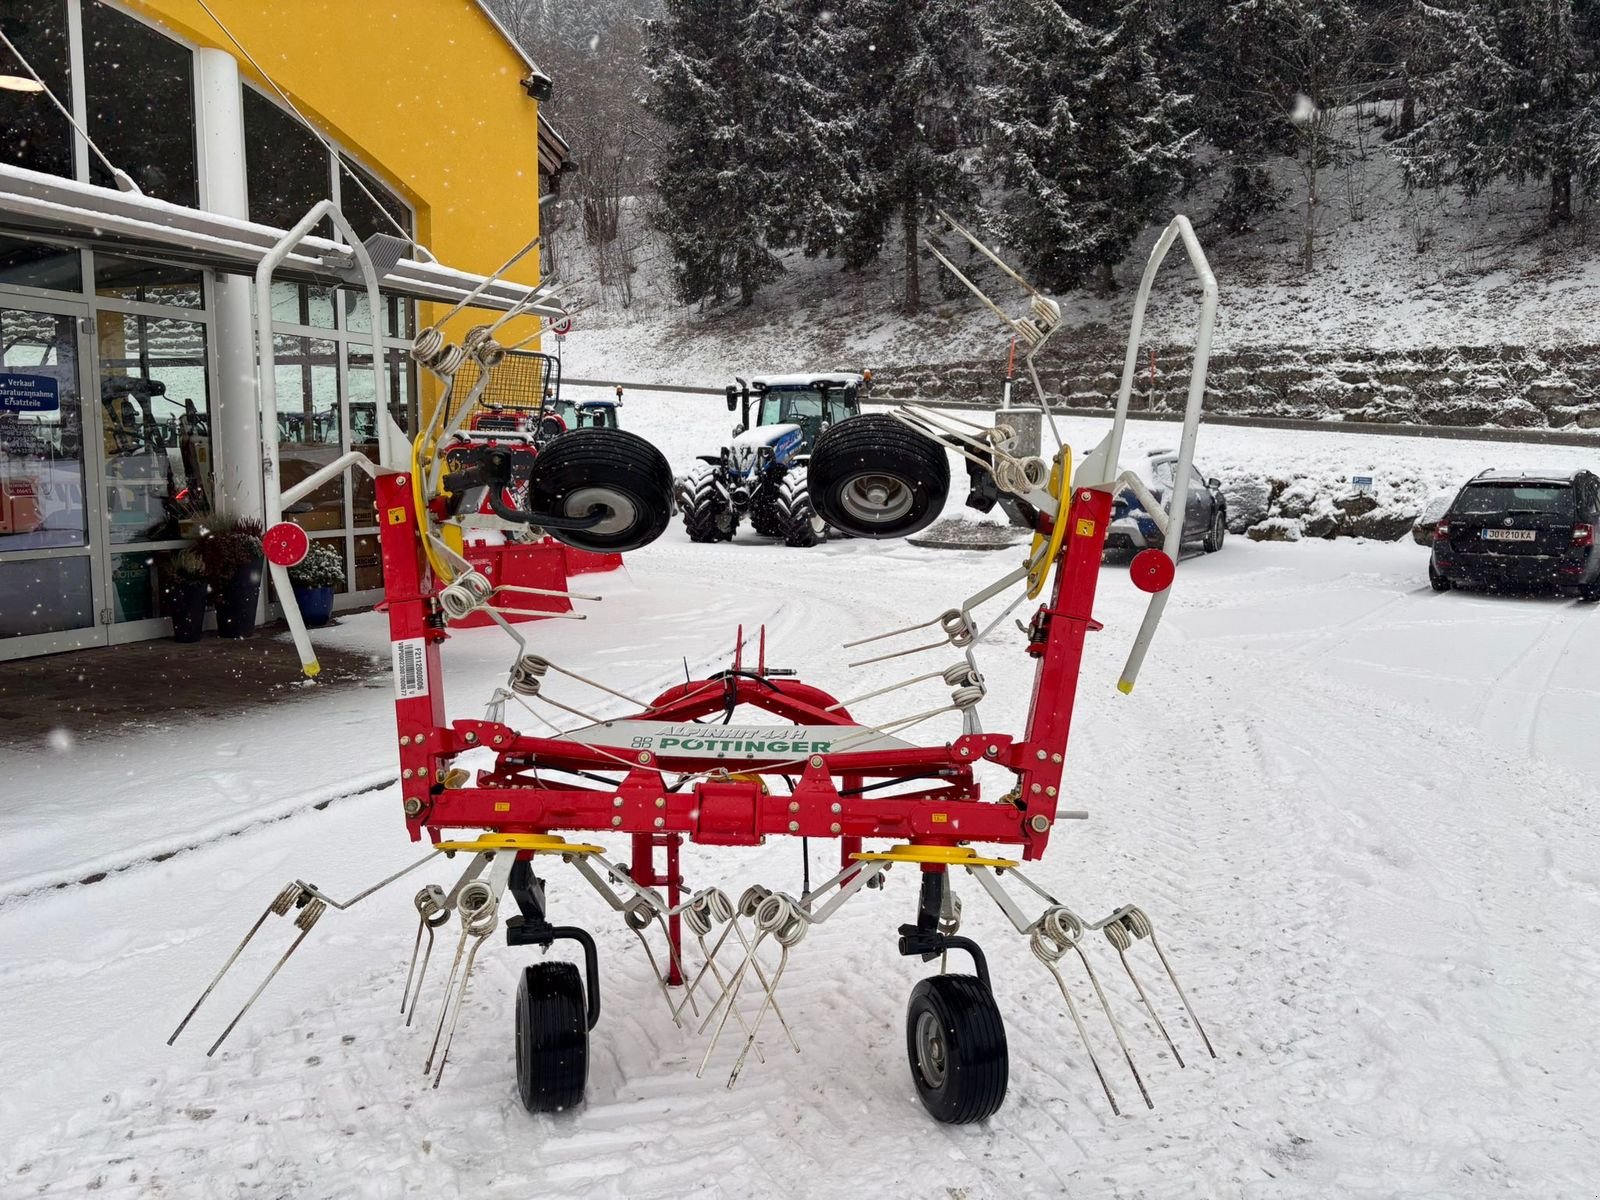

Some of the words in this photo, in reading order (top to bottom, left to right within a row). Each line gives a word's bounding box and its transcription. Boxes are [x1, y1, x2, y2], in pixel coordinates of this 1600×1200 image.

[8, 378, 35, 388] Verkauf
[4, 397, 41, 407] Ersatzteile
[655, 726, 760, 739] ALPINHIT
[790, 730, 808, 740] H
[659, 738, 831, 753] PÖTTINGER
